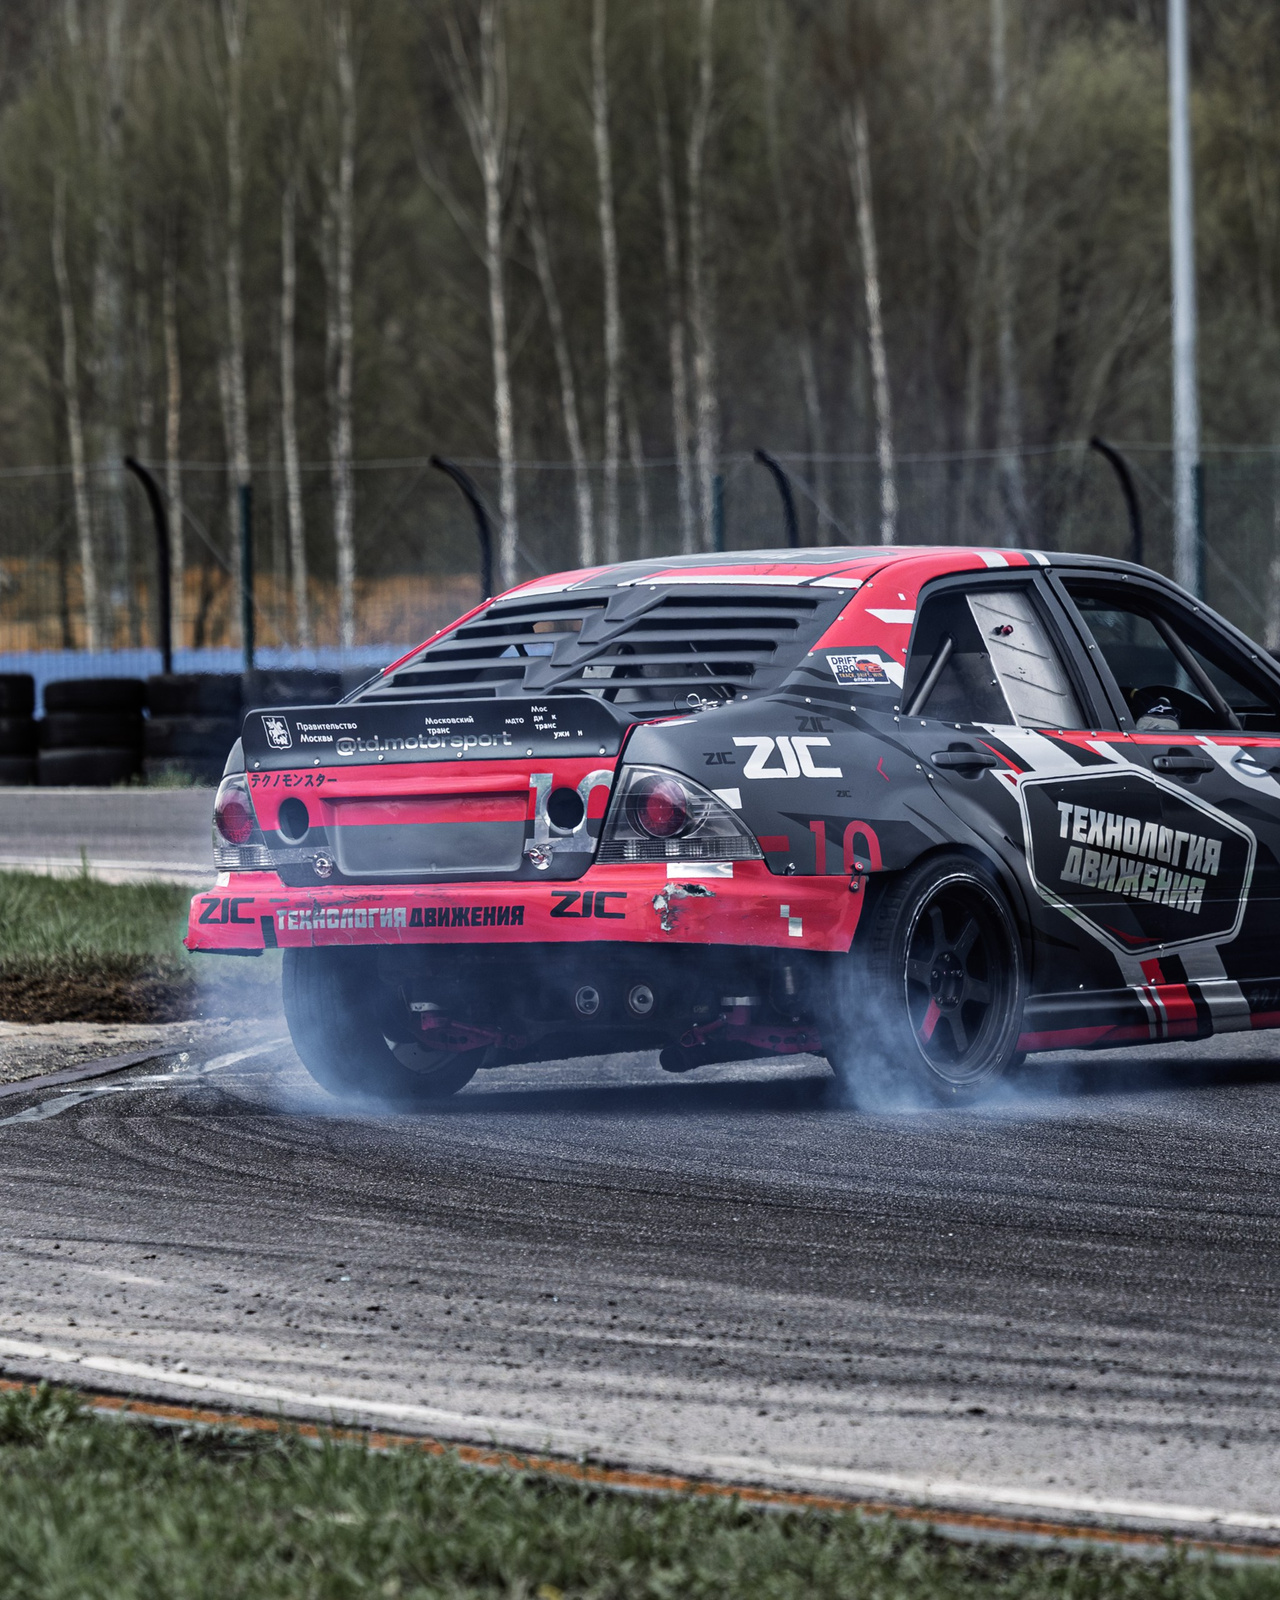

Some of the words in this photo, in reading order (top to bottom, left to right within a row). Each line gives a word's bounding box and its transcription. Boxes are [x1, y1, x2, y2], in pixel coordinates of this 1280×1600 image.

[831, 656, 858, 665] DRIFT
[837, 664, 856, 673] BRO
[531, 705, 548, 713] Мос
[296, 721, 358, 732] Правительство
[425, 715, 475, 725] Московский
[535, 722, 557, 731] транс
[795, 715, 835, 733] ZIC
[300, 733, 334, 744] Москвы
[427, 726, 450, 736] транс
[553, 730, 570, 739] ужи
[335, 730, 512, 757] @td.motorsport
[703, 751, 737, 766] ZIC
[732, 736, 844, 780] ZIC
[251, 773, 338, 788] テクノモンスター
[836, 790, 852, 798] ZIC
[1057, 801, 1223, 876] ТЕХНОЛОГИЯ
[809, 820, 883, 875] 10
[1060, 846, 1207, 915] ДВИЖЕНИЯ
[199, 897, 256, 924] ZIC
[550, 890, 628, 919] ZIC
[276, 907, 407, 930] ТЕХНОЛОГИЯ
[409, 905, 525, 928] ДВИЖЕНИЯ
